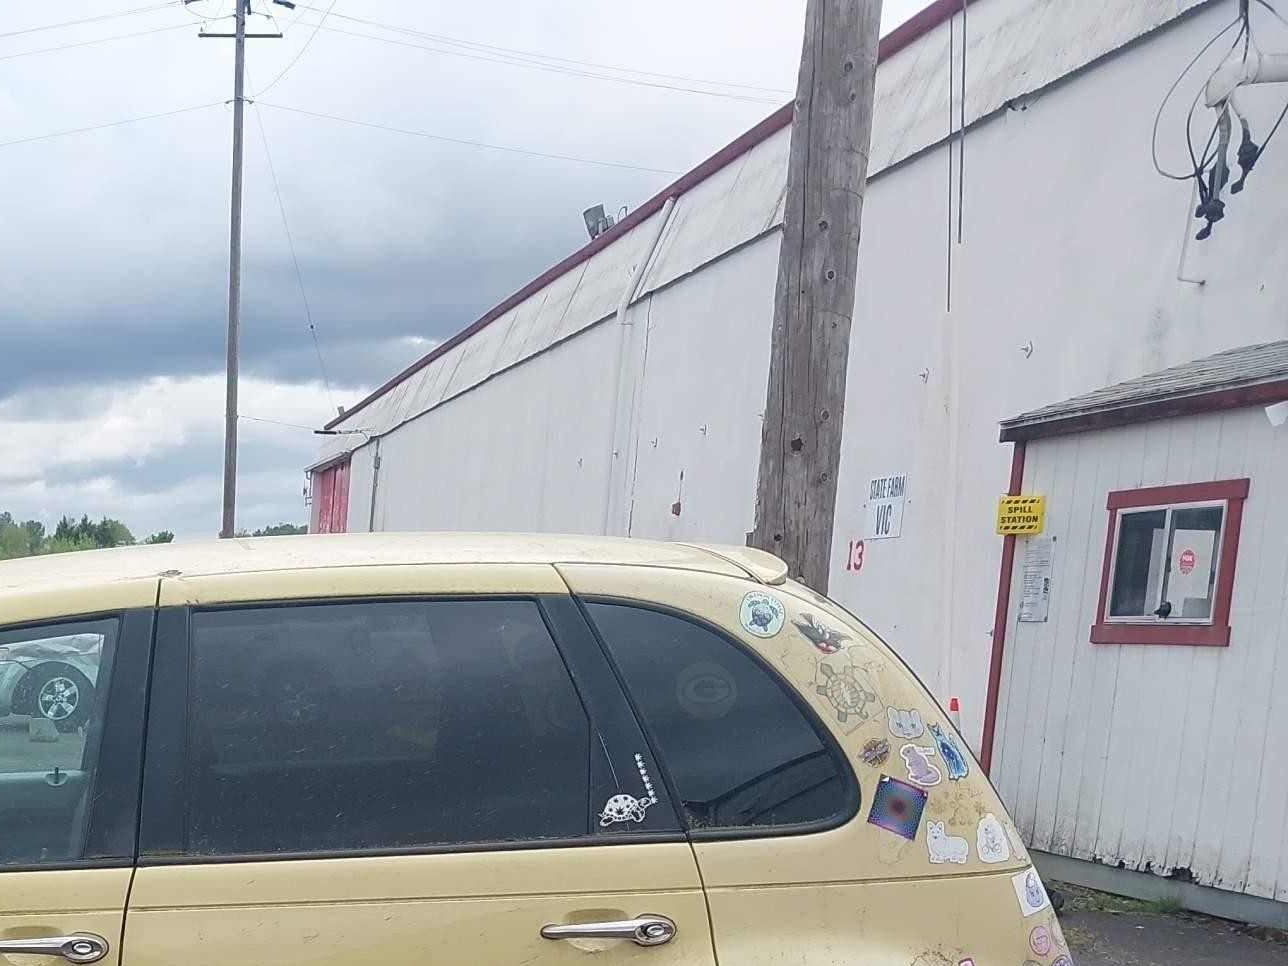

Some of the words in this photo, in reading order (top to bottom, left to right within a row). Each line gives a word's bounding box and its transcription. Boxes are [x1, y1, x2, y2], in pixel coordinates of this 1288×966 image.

[870, 479, 887, 500] STATE
[887, 476, 905, 498] FARM
[876, 504, 892, 535] VIC
[1000, 515, 1039, 524] STATION
[1007, 506, 1033, 514] SPILL
[846, 540, 864, 571] 13
